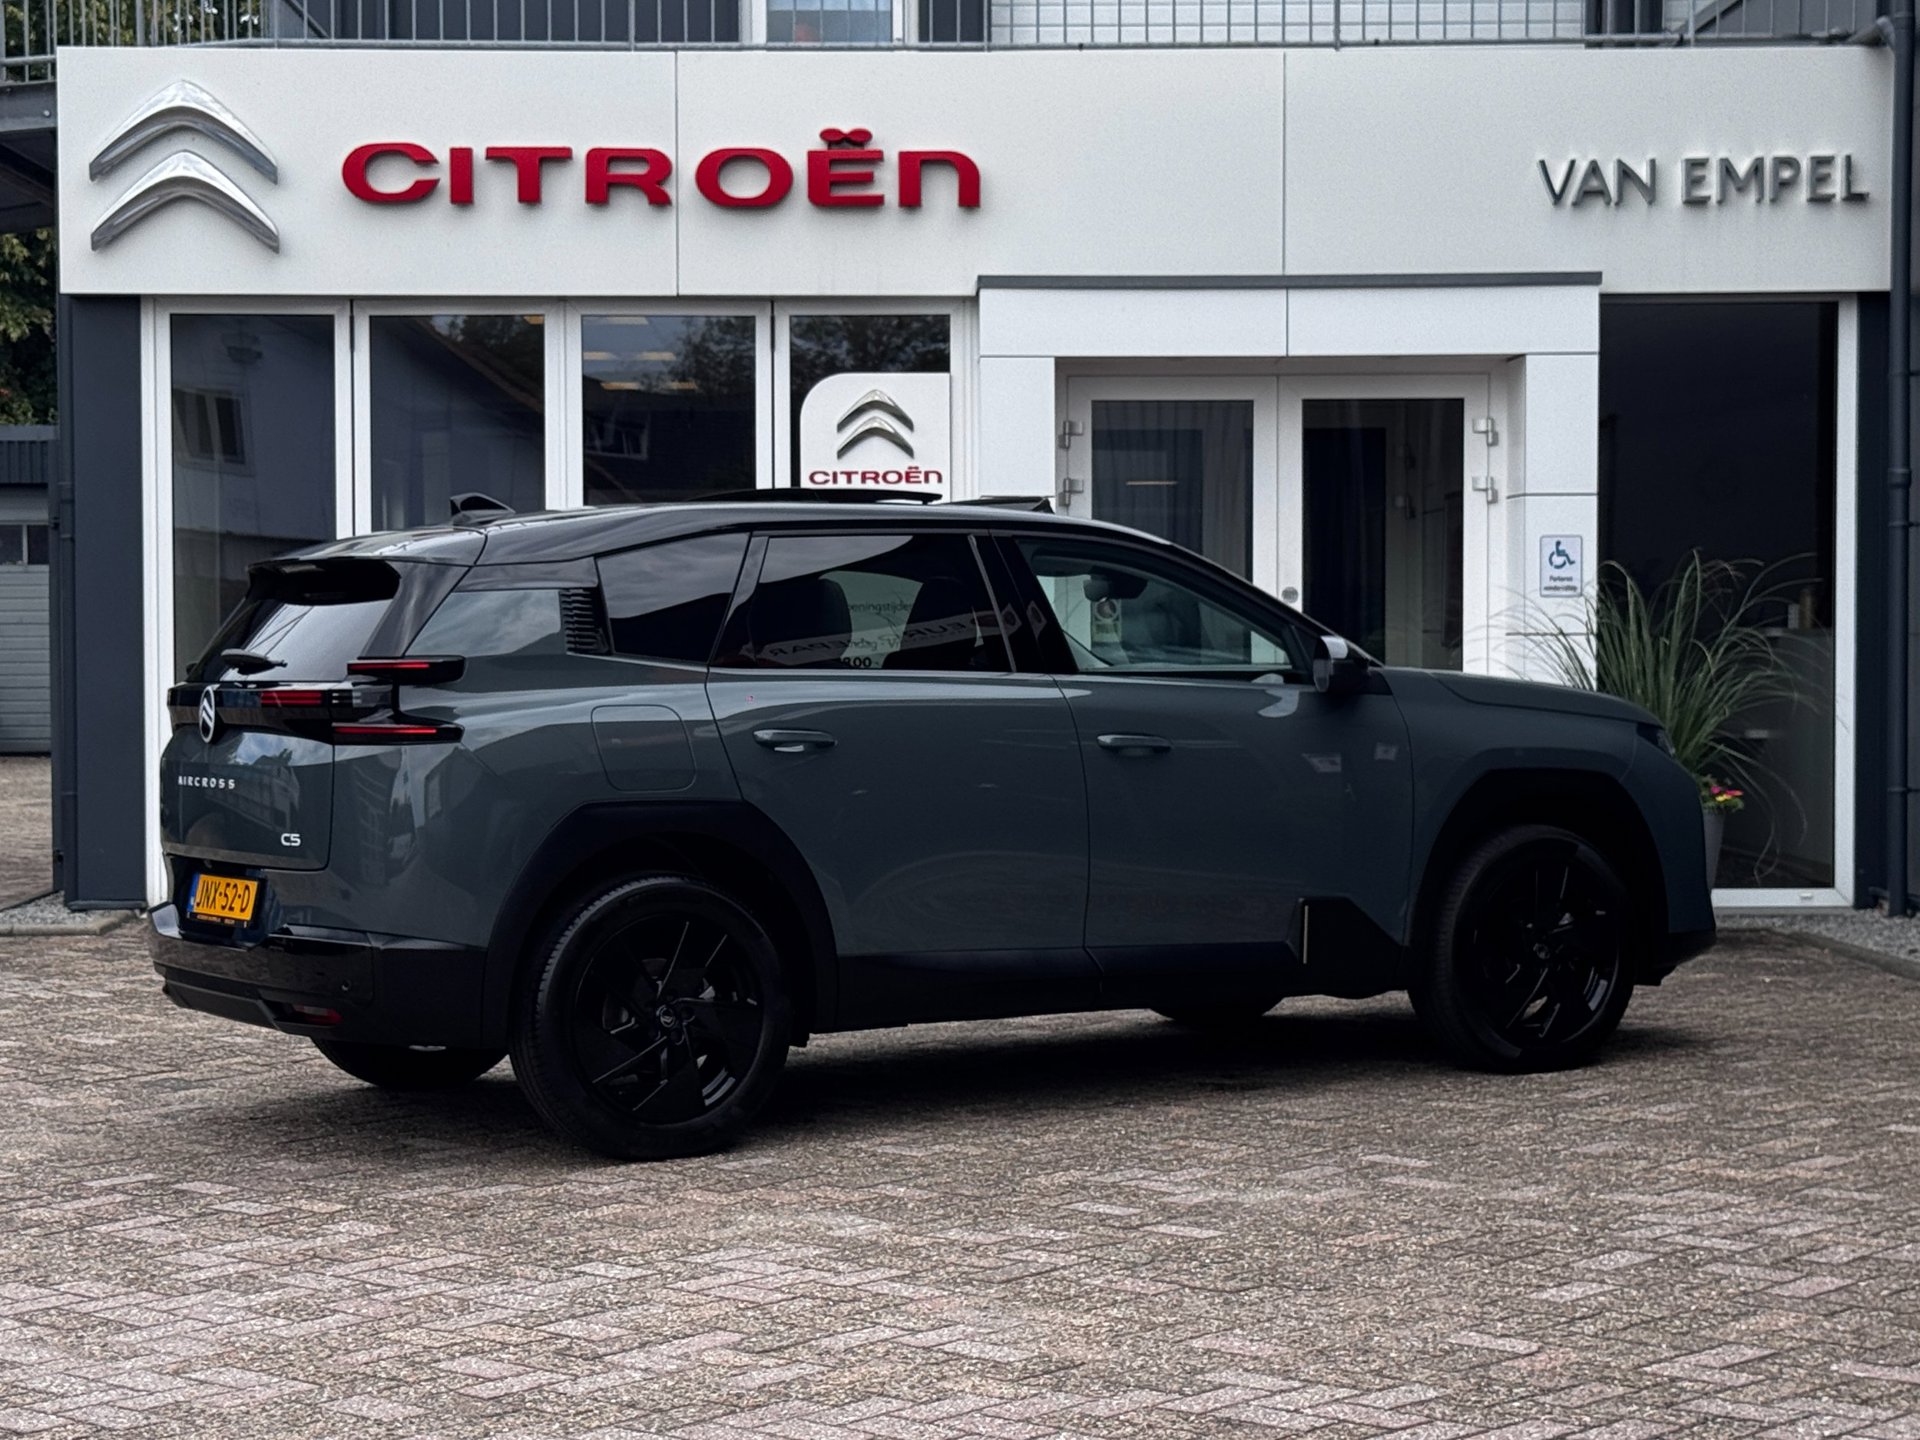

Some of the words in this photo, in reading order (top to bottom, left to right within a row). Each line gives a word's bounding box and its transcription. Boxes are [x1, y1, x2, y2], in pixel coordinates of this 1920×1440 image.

[342, 128, 981, 208] CITROËN
[1537, 157, 1657, 207] VAN
[1681, 153, 1869, 206] EMPEL
[808, 466, 943, 486] CITROËN
[177, 775, 236, 789] AIRCROSS
[280, 832, 302, 847] C5
[196, 879, 251, 913] JNX-52-D
